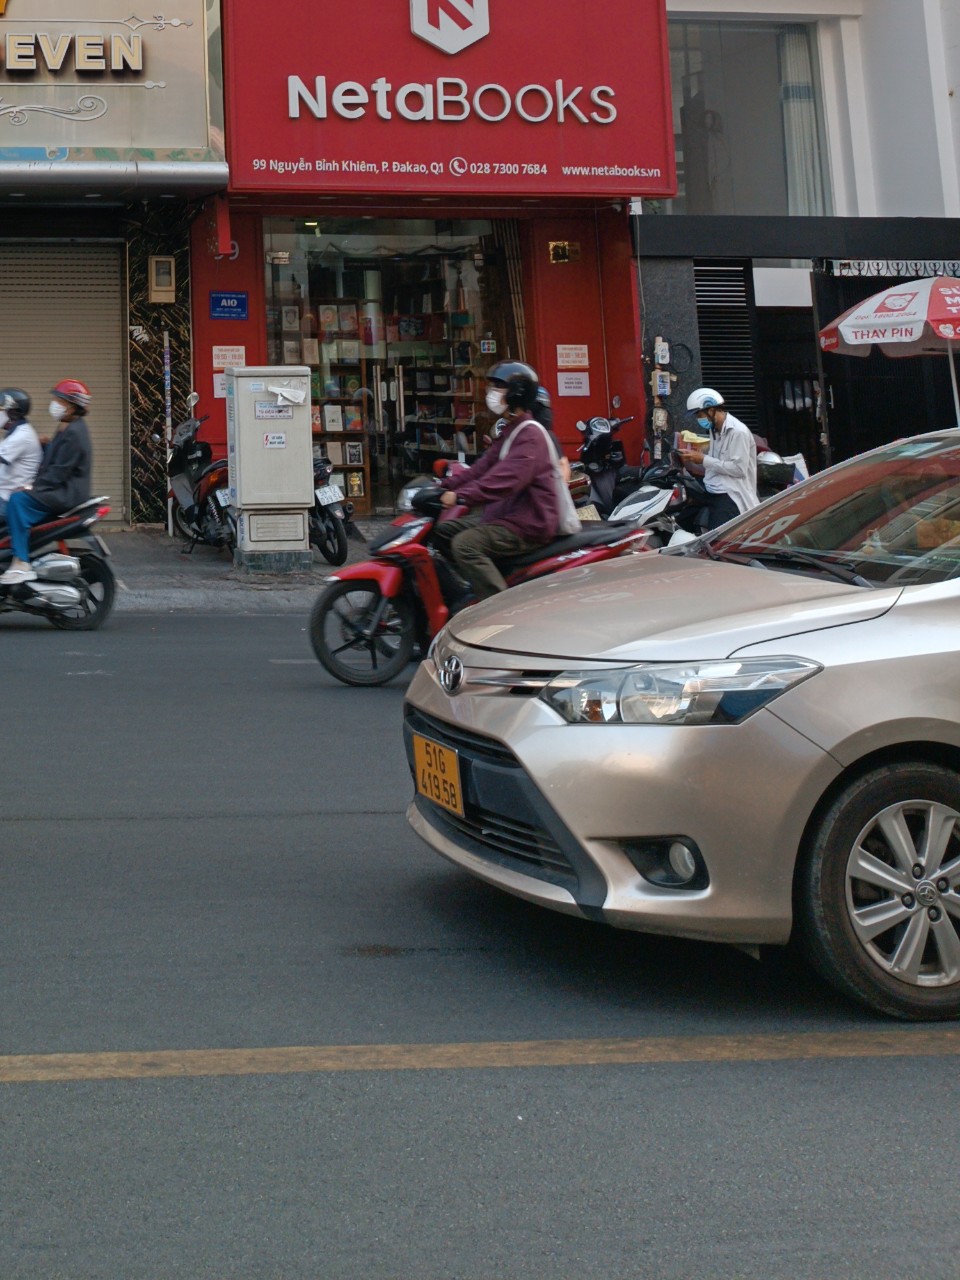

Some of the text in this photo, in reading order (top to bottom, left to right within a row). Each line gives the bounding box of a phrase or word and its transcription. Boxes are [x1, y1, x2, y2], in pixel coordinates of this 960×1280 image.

[287, 75, 618, 124] NetaBooks
[252, 159, 267, 170] 99
[269, 157, 312, 174] Nguyễn
[315, 158, 339, 172] Bỉnh
[342, 161, 380, 174] Khiêm,
[381, 161, 390, 173] P.
[392, 161, 429, 175] Đakao,
[470, 162, 490, 174] 028
[493, 163, 519, 174] 7300
[521, 163, 548, 175] 7684
[561, 164, 661, 178] www.netabooks.vn
[852, 328, 887, 341] THAY
[891, 327, 914, 338] PIN
[425, 742, 446, 774] 51G
[422, 768, 458, 809] 419.58
